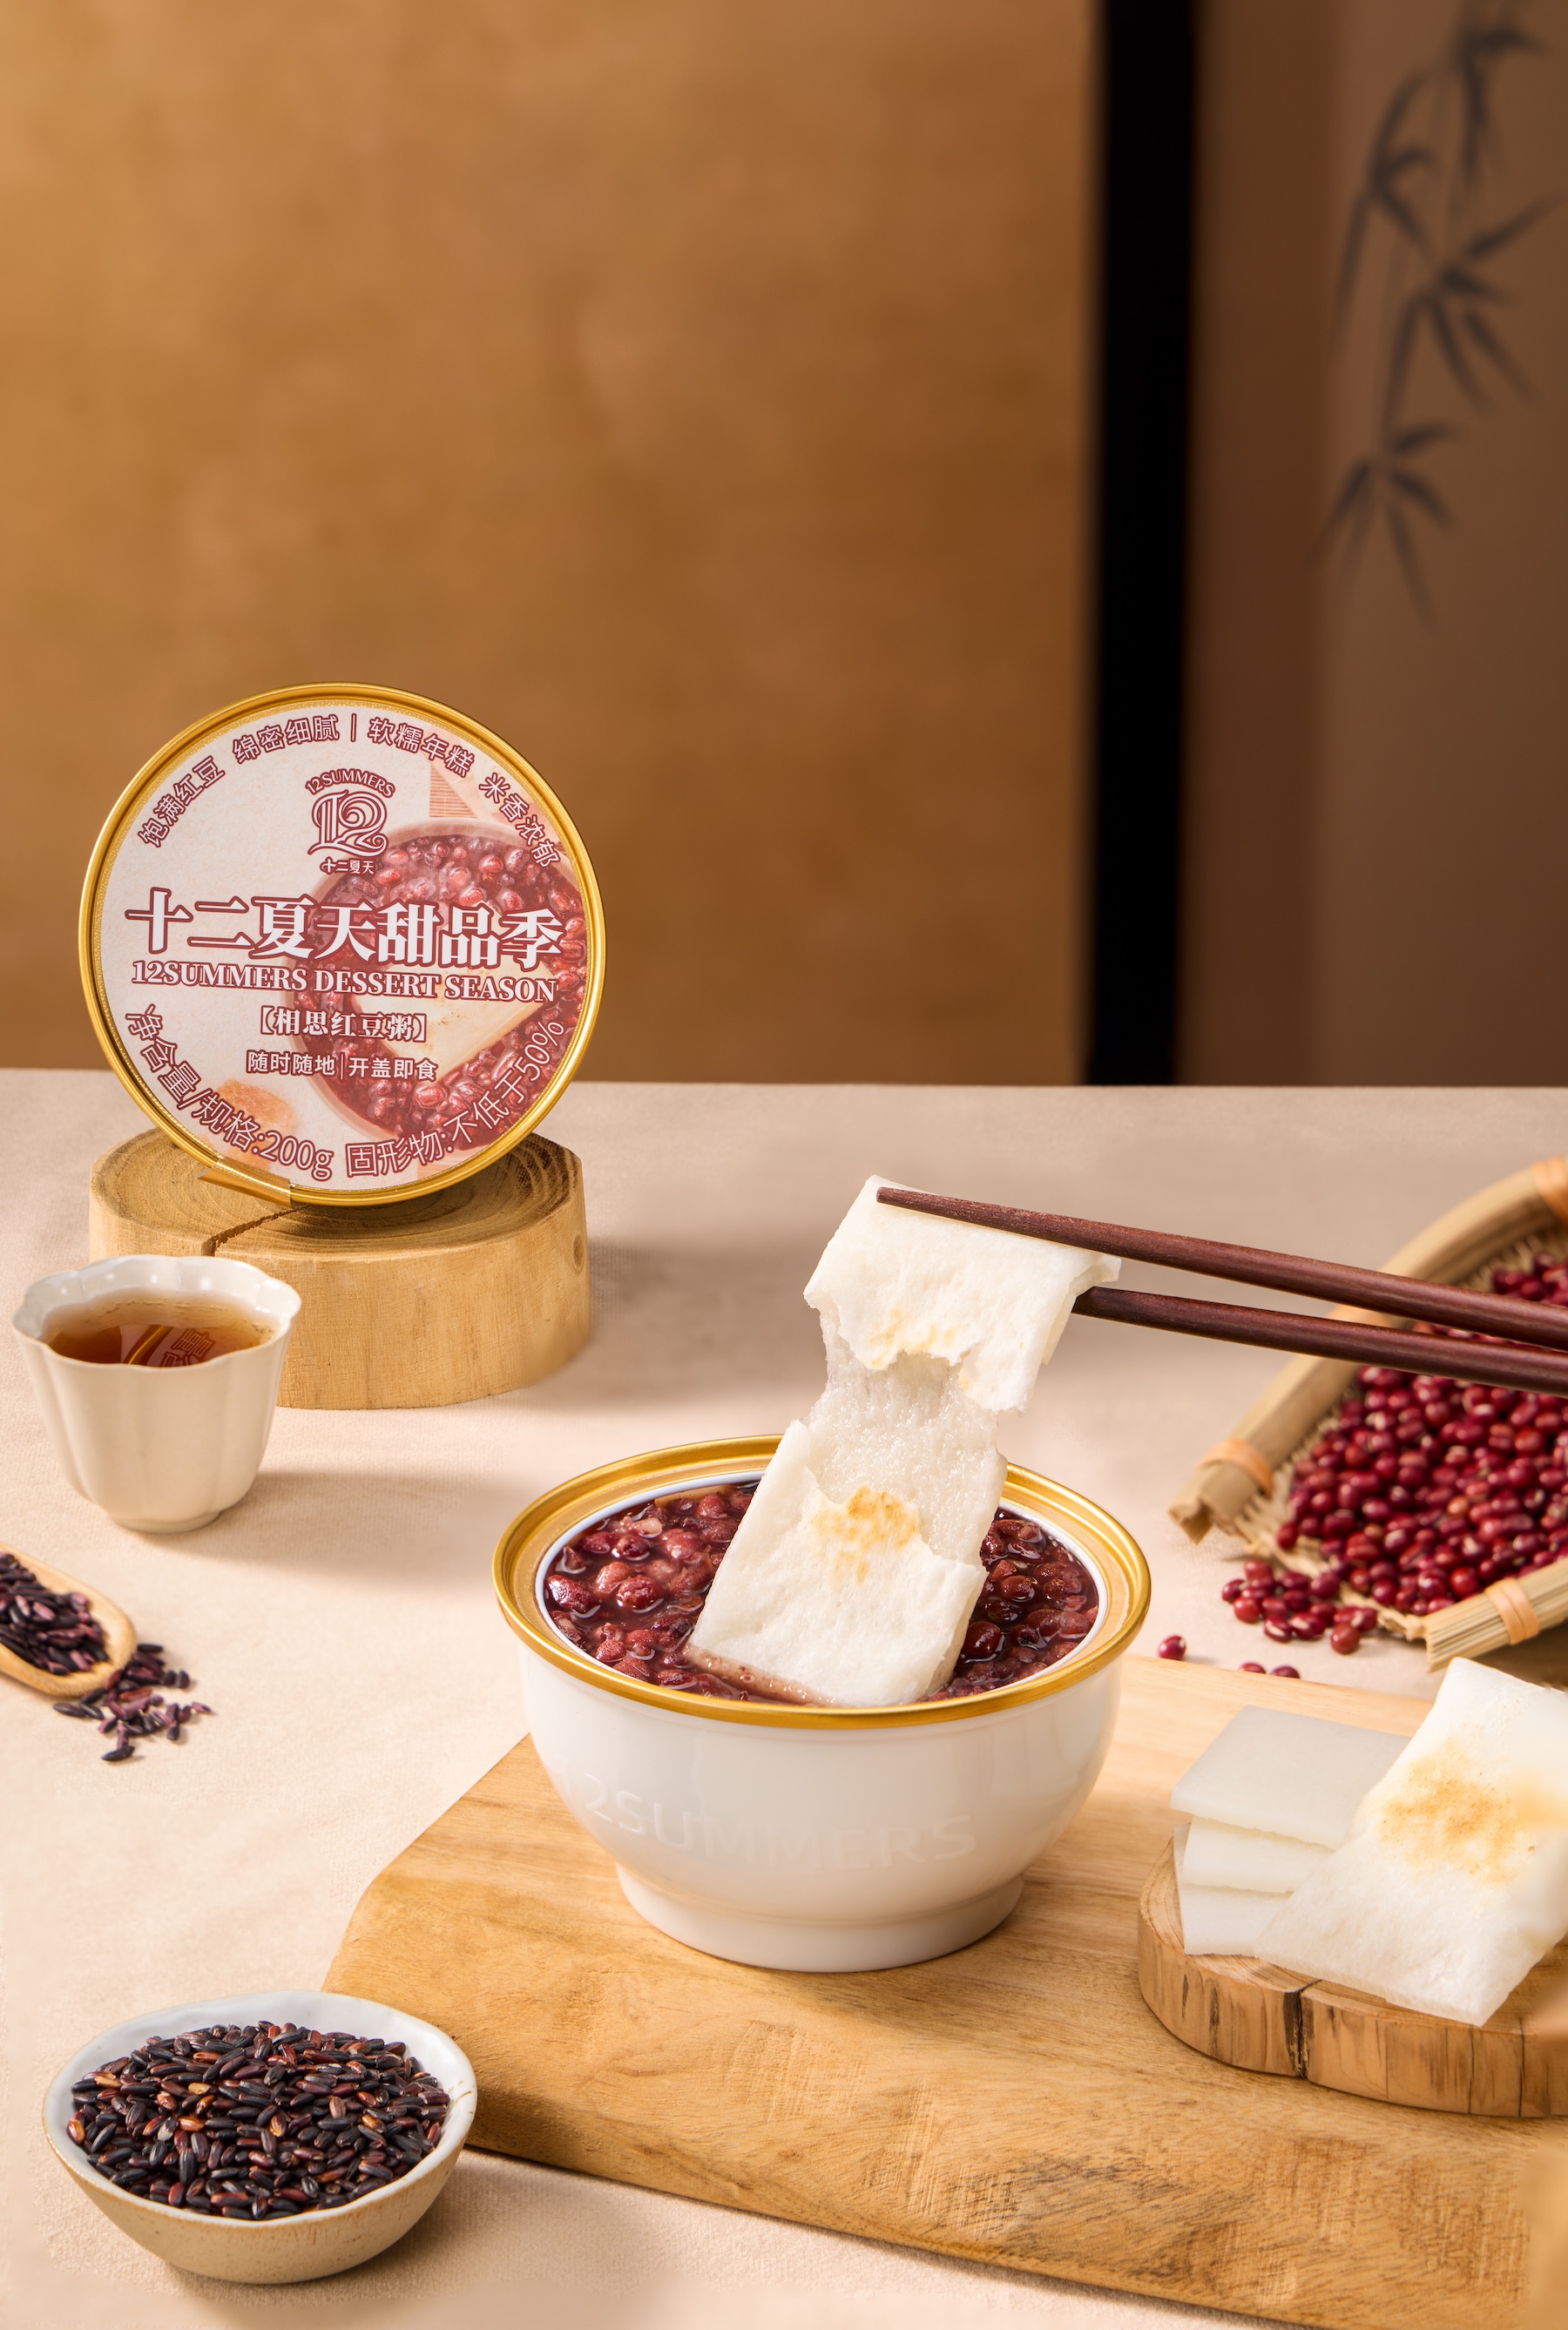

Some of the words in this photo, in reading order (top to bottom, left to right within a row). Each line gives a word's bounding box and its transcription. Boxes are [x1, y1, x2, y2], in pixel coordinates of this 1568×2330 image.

[138, 755, 226, 848] 饱满红豆
[233, 714, 339, 764] 绵密细腻
[368, 716, 475, 778] 软糯年糕
[479, 773, 561, 868] 米香浓郁
[320, 856, 375, 875] 十二夏天
[125, 887, 566, 971] 十二夏天甜品季
[132, 960, 308, 991] 12SUMMERS
[314, 969, 441, 998] DESSERT
[444, 974, 558, 1003] SEASON
